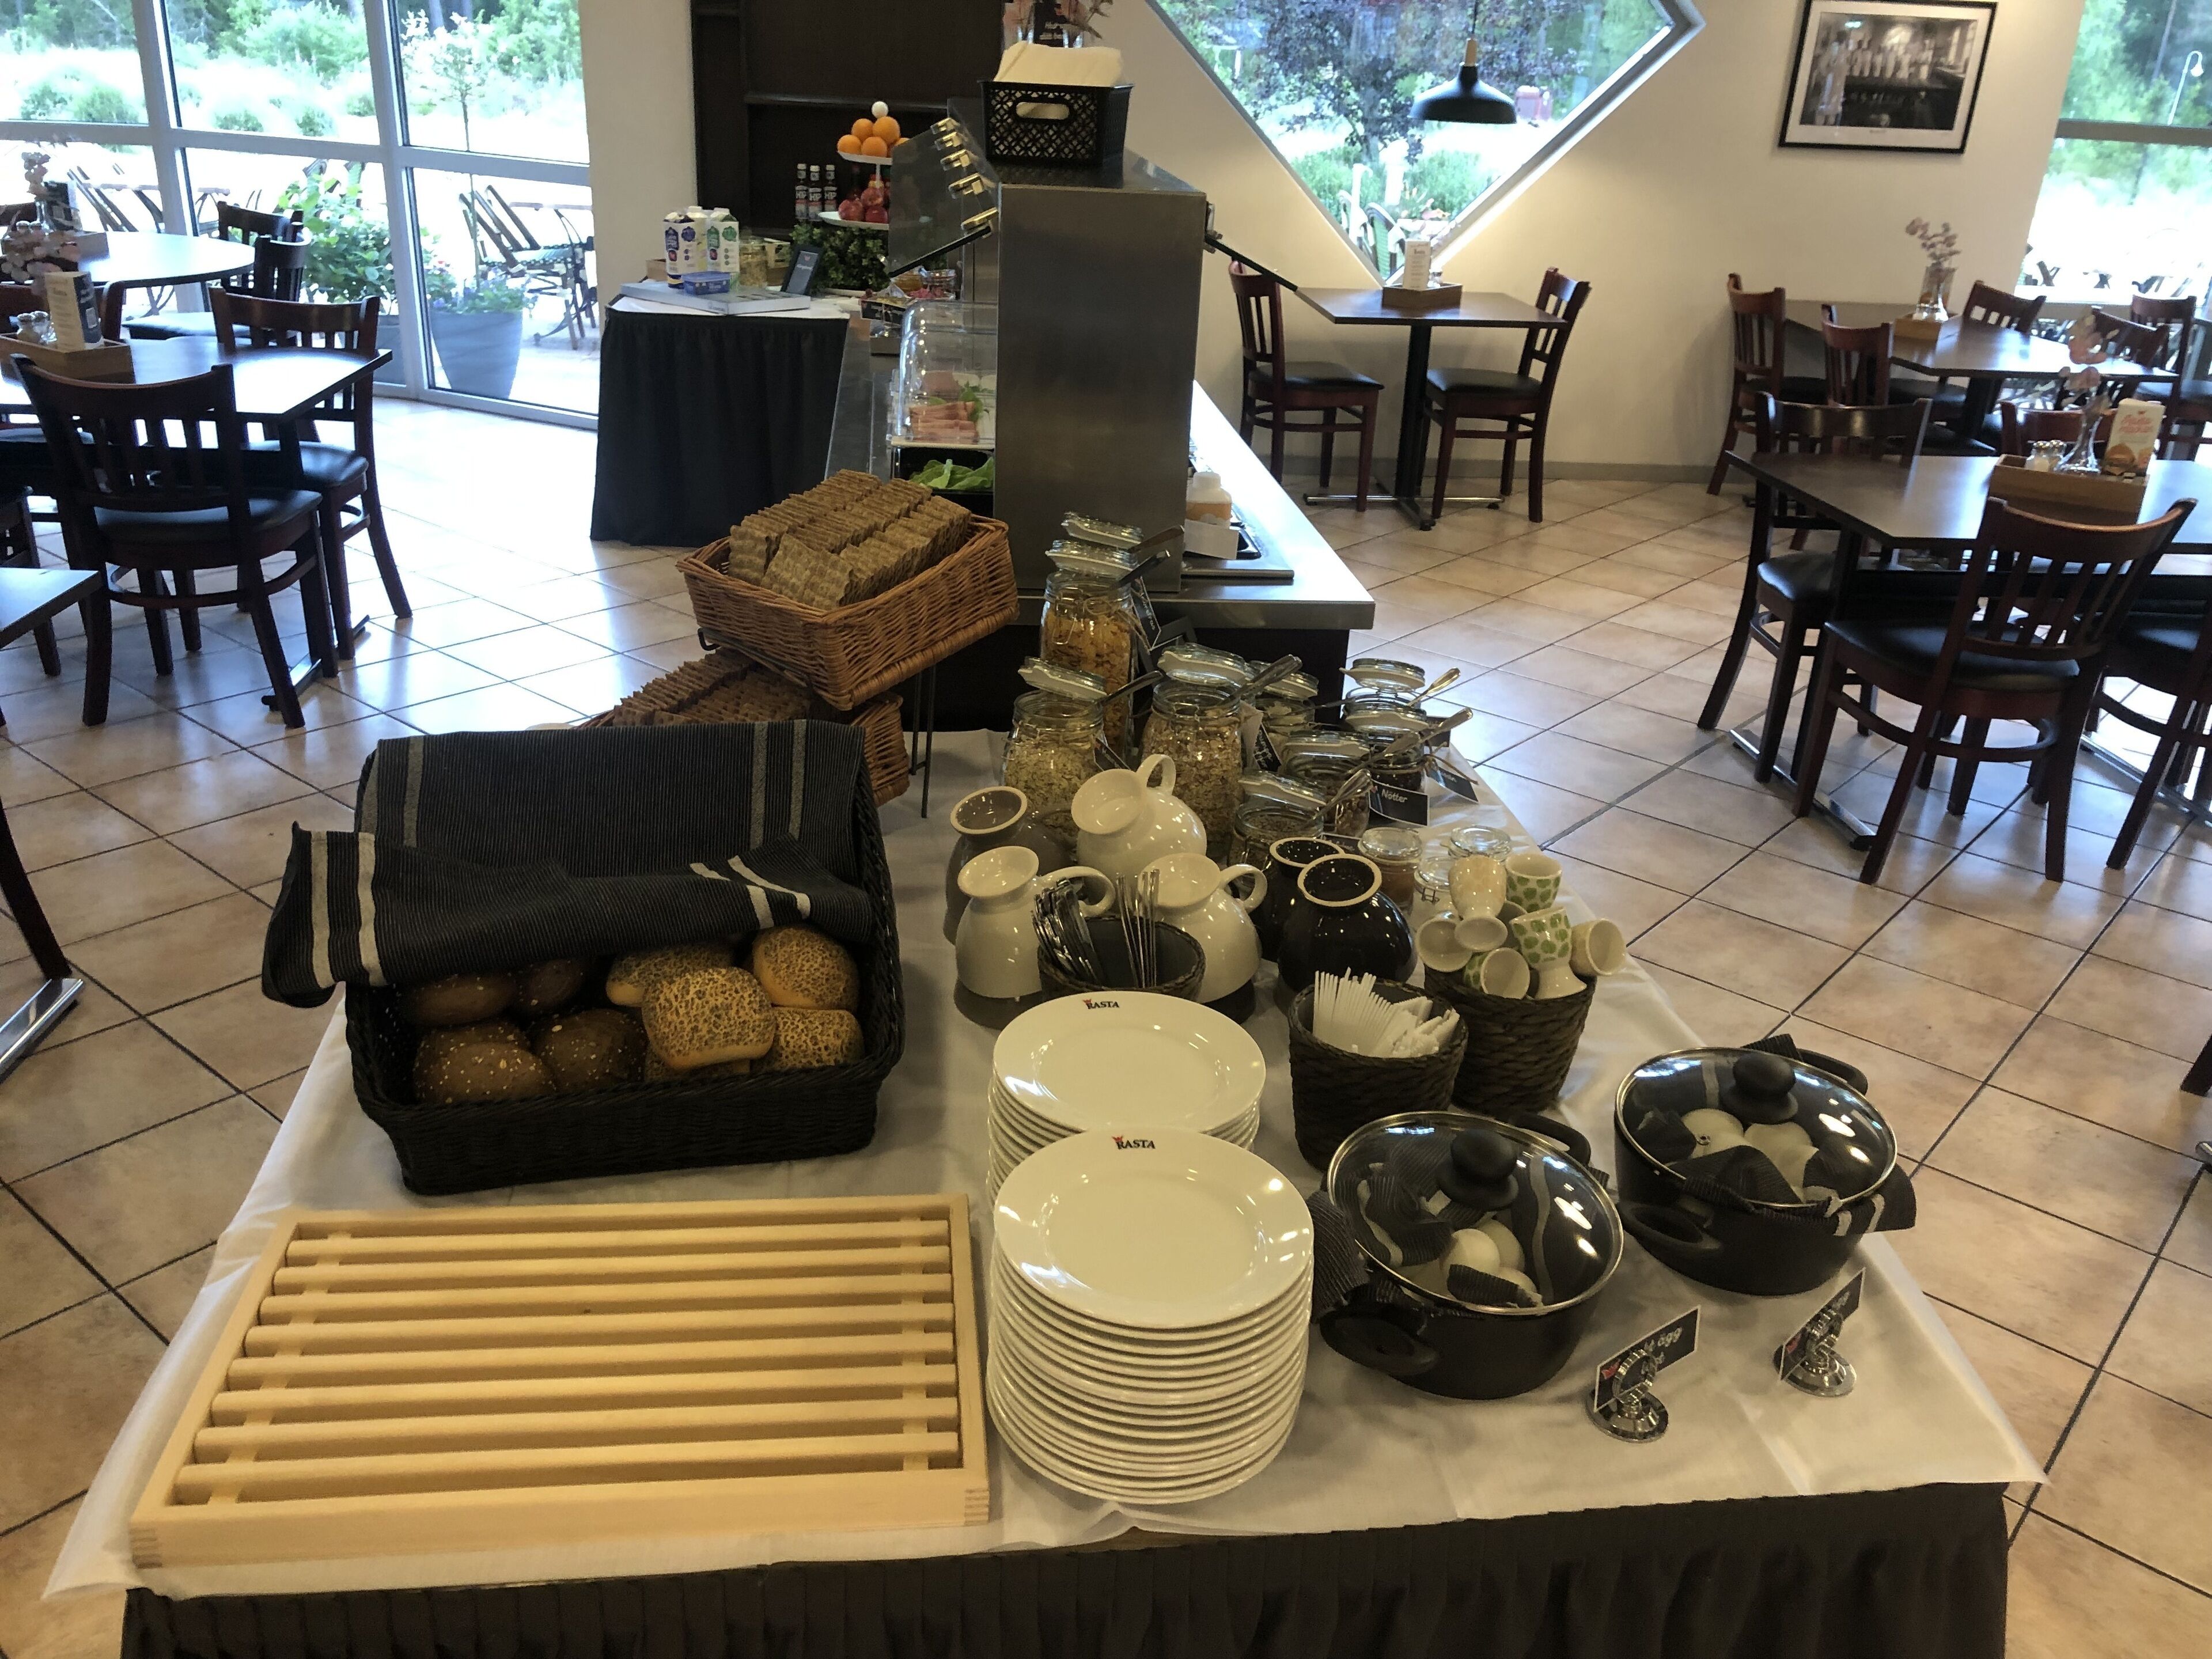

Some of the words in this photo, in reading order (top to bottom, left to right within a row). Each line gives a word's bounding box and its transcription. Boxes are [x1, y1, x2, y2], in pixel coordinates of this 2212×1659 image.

[1381, 788, 1408, 803] Nötter
[1086, 1001, 1120, 1009] RASTA
[1116, 1139, 1156, 1150] RASTA
[1657, 1327, 1683, 1347] ägg
